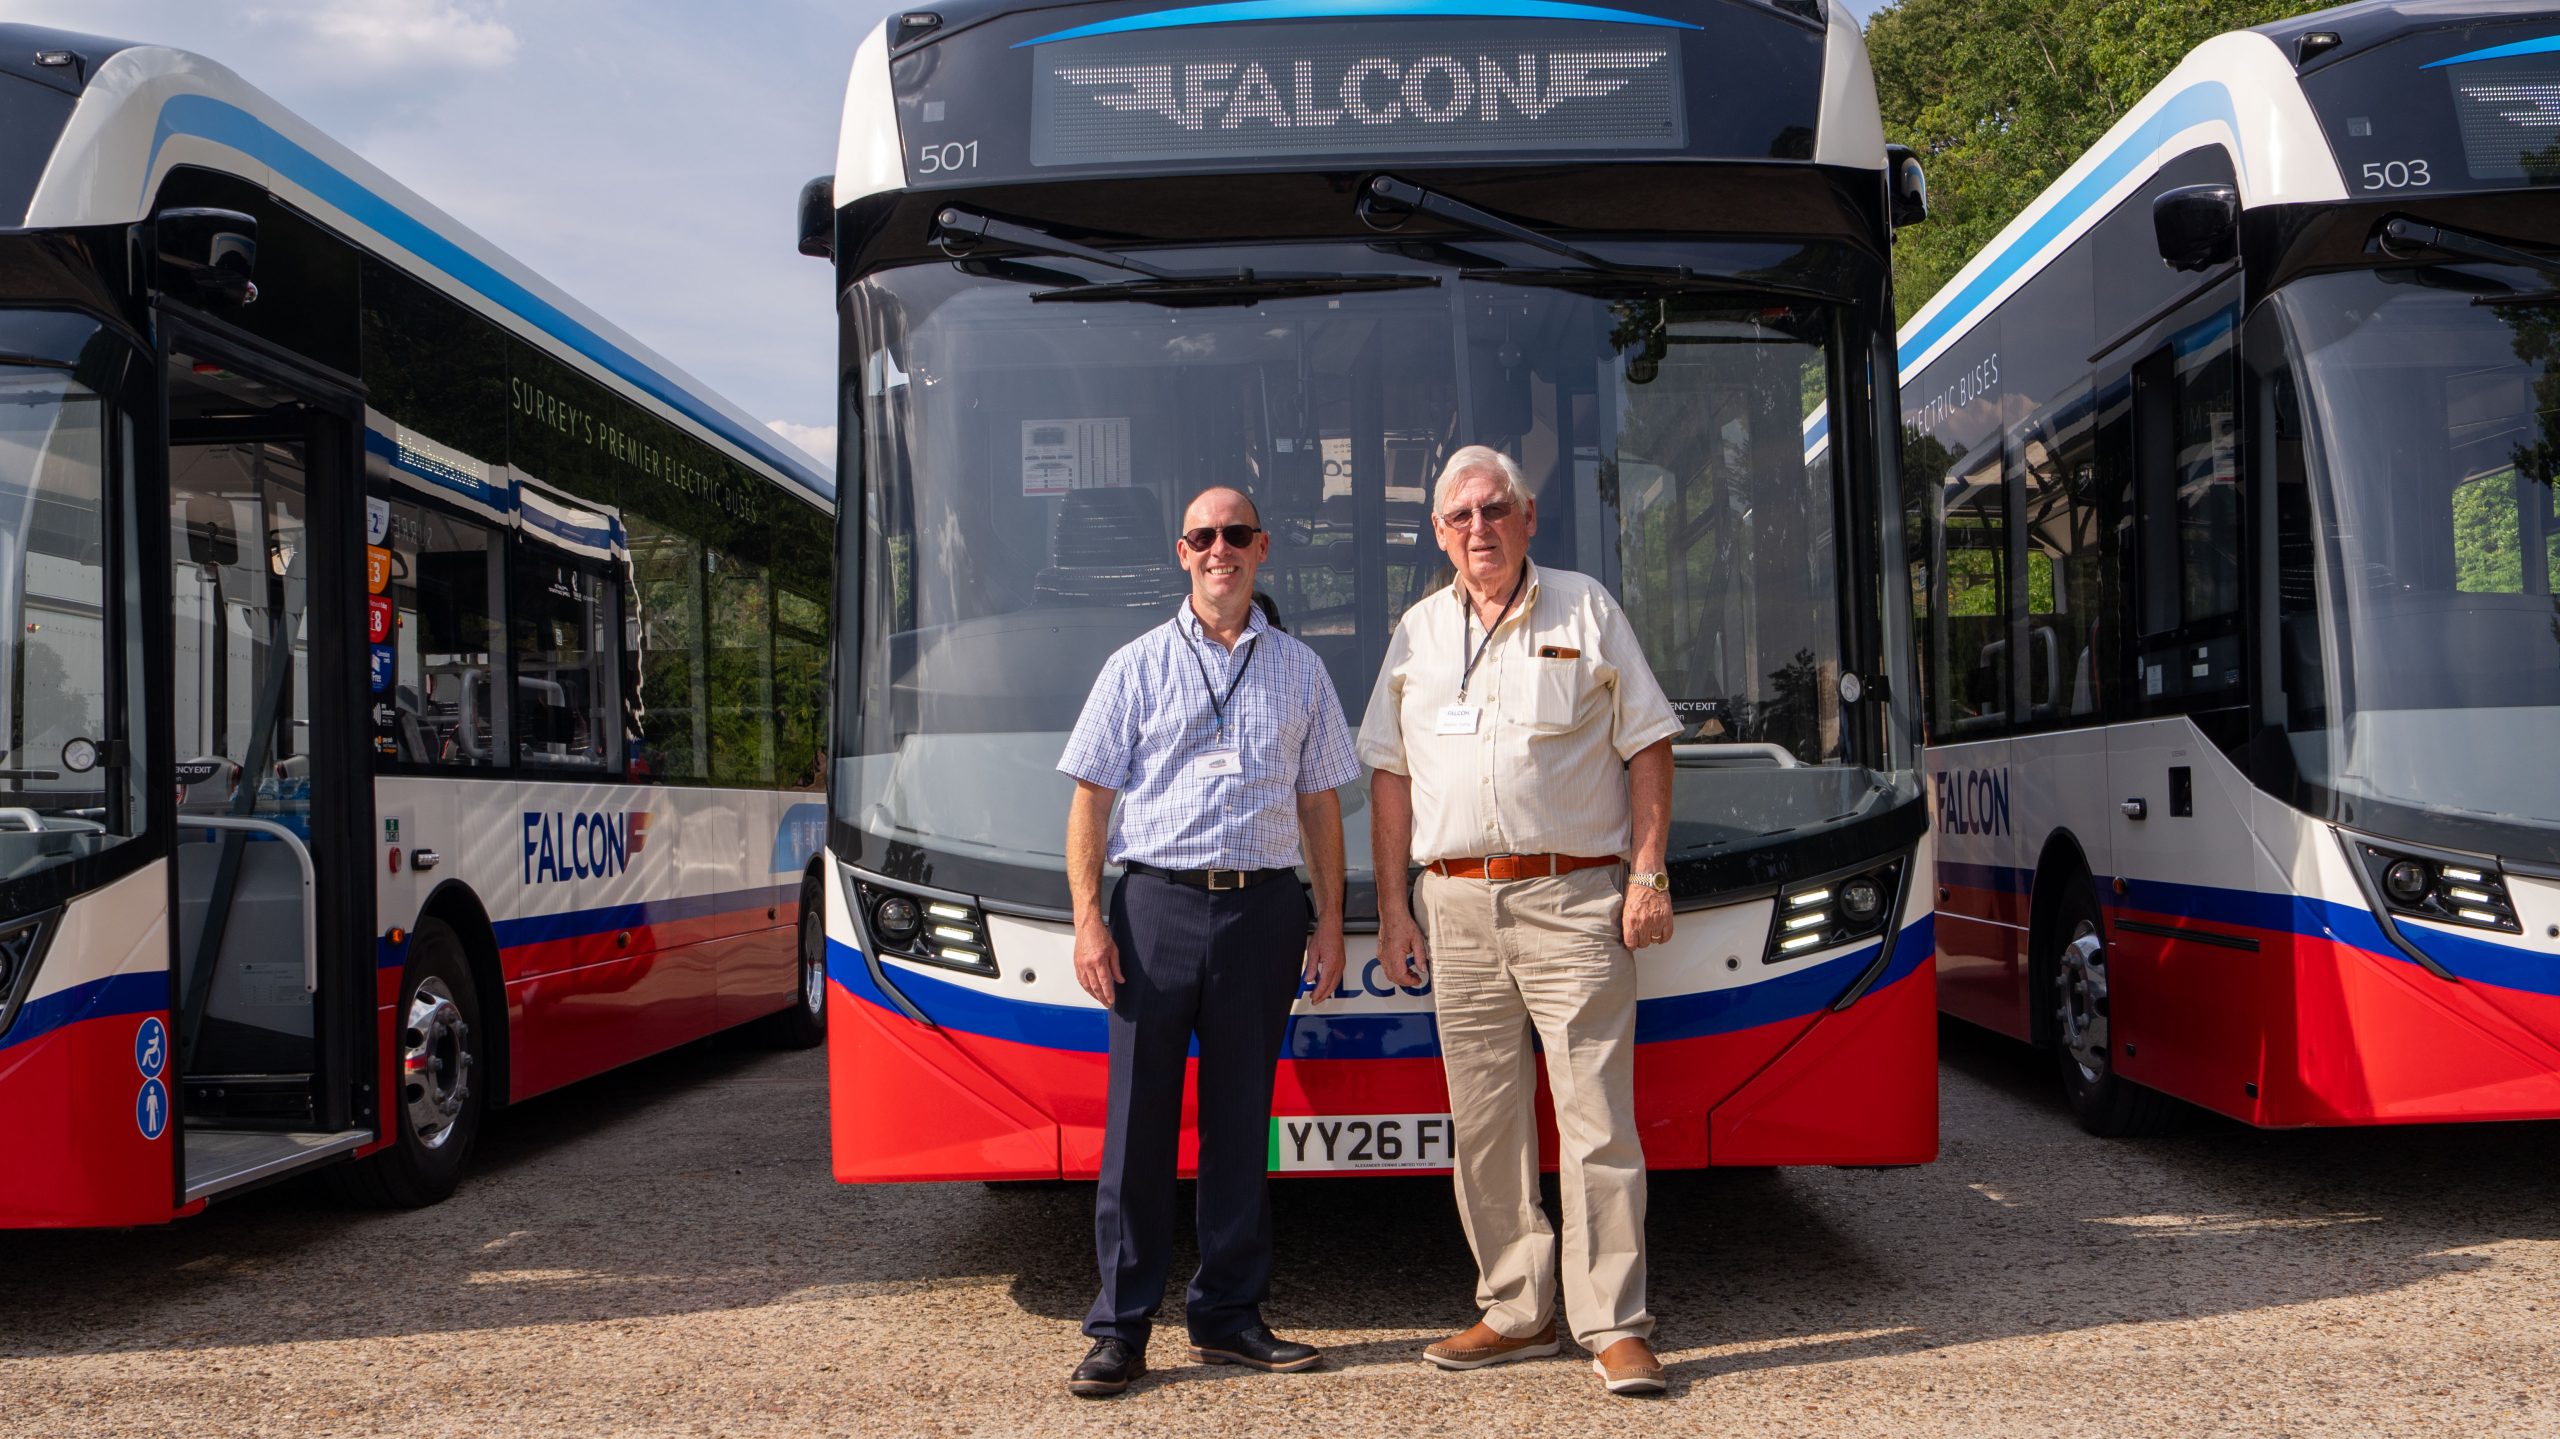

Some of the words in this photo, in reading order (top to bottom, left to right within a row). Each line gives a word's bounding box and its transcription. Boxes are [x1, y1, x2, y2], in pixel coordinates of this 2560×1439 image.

[1184, 53, 1540, 130] FALCON
[919, 139, 979, 174] 501
[2362, 159, 2431, 190] 503
[1906, 385, 1955, 446] ELECTRIC
[1960, 352, 1999, 407] BUSES
[512, 376, 593, 445] SURREY'S
[600, 422, 660, 478] PREMIER
[665, 455, 721, 508] ELECTRIC
[725, 486, 758, 525] BUSES
[1695, 702, 1717, 711] EXIT
[194, 766, 212, 774] EXIT
[1936, 767, 2010, 837] FALCON
[523, 812, 625, 885] FALCON
[1287, 1120, 1403, 1162] YY26
